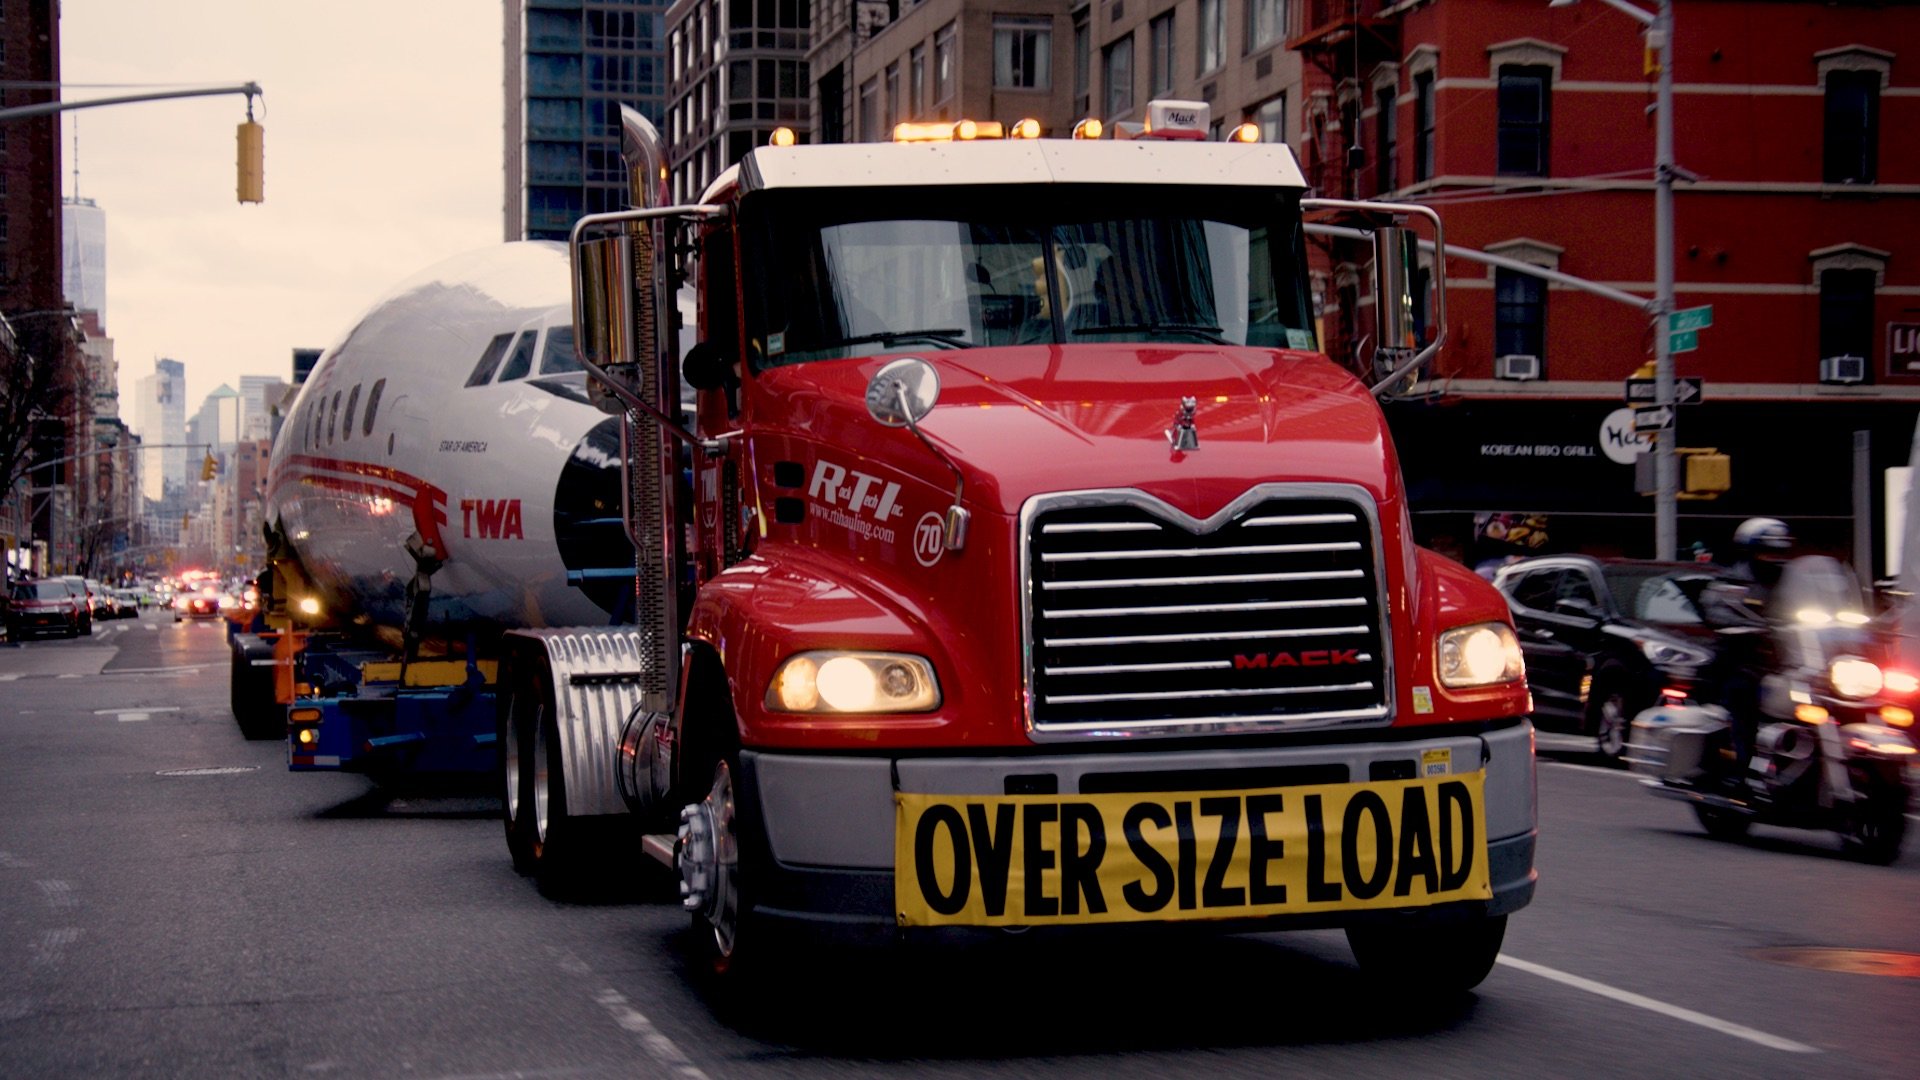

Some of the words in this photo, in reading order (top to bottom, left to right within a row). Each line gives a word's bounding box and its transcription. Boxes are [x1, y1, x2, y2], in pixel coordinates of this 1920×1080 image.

[1168, 111, 1196, 124] Mack
[439, 440, 453, 453] STAR
[453, 440, 463, 453] OF
[461, 440, 488, 454] AMERICA
[1480, 444, 1533, 456] KOREAN
[1534, 445, 1561, 456] BBQ
[1563, 445, 1597, 457] GRILL
[461, 499, 524, 540] TWA
[810, 502, 895, 544] www.rtihauling.com
[919, 525, 942, 554] 70
[1233, 648, 1359, 671] MACK
[914, 802, 1108, 917] OVER
[1122, 794, 1287, 912] SIZE
[1304, 781, 1474, 902] LOAD
